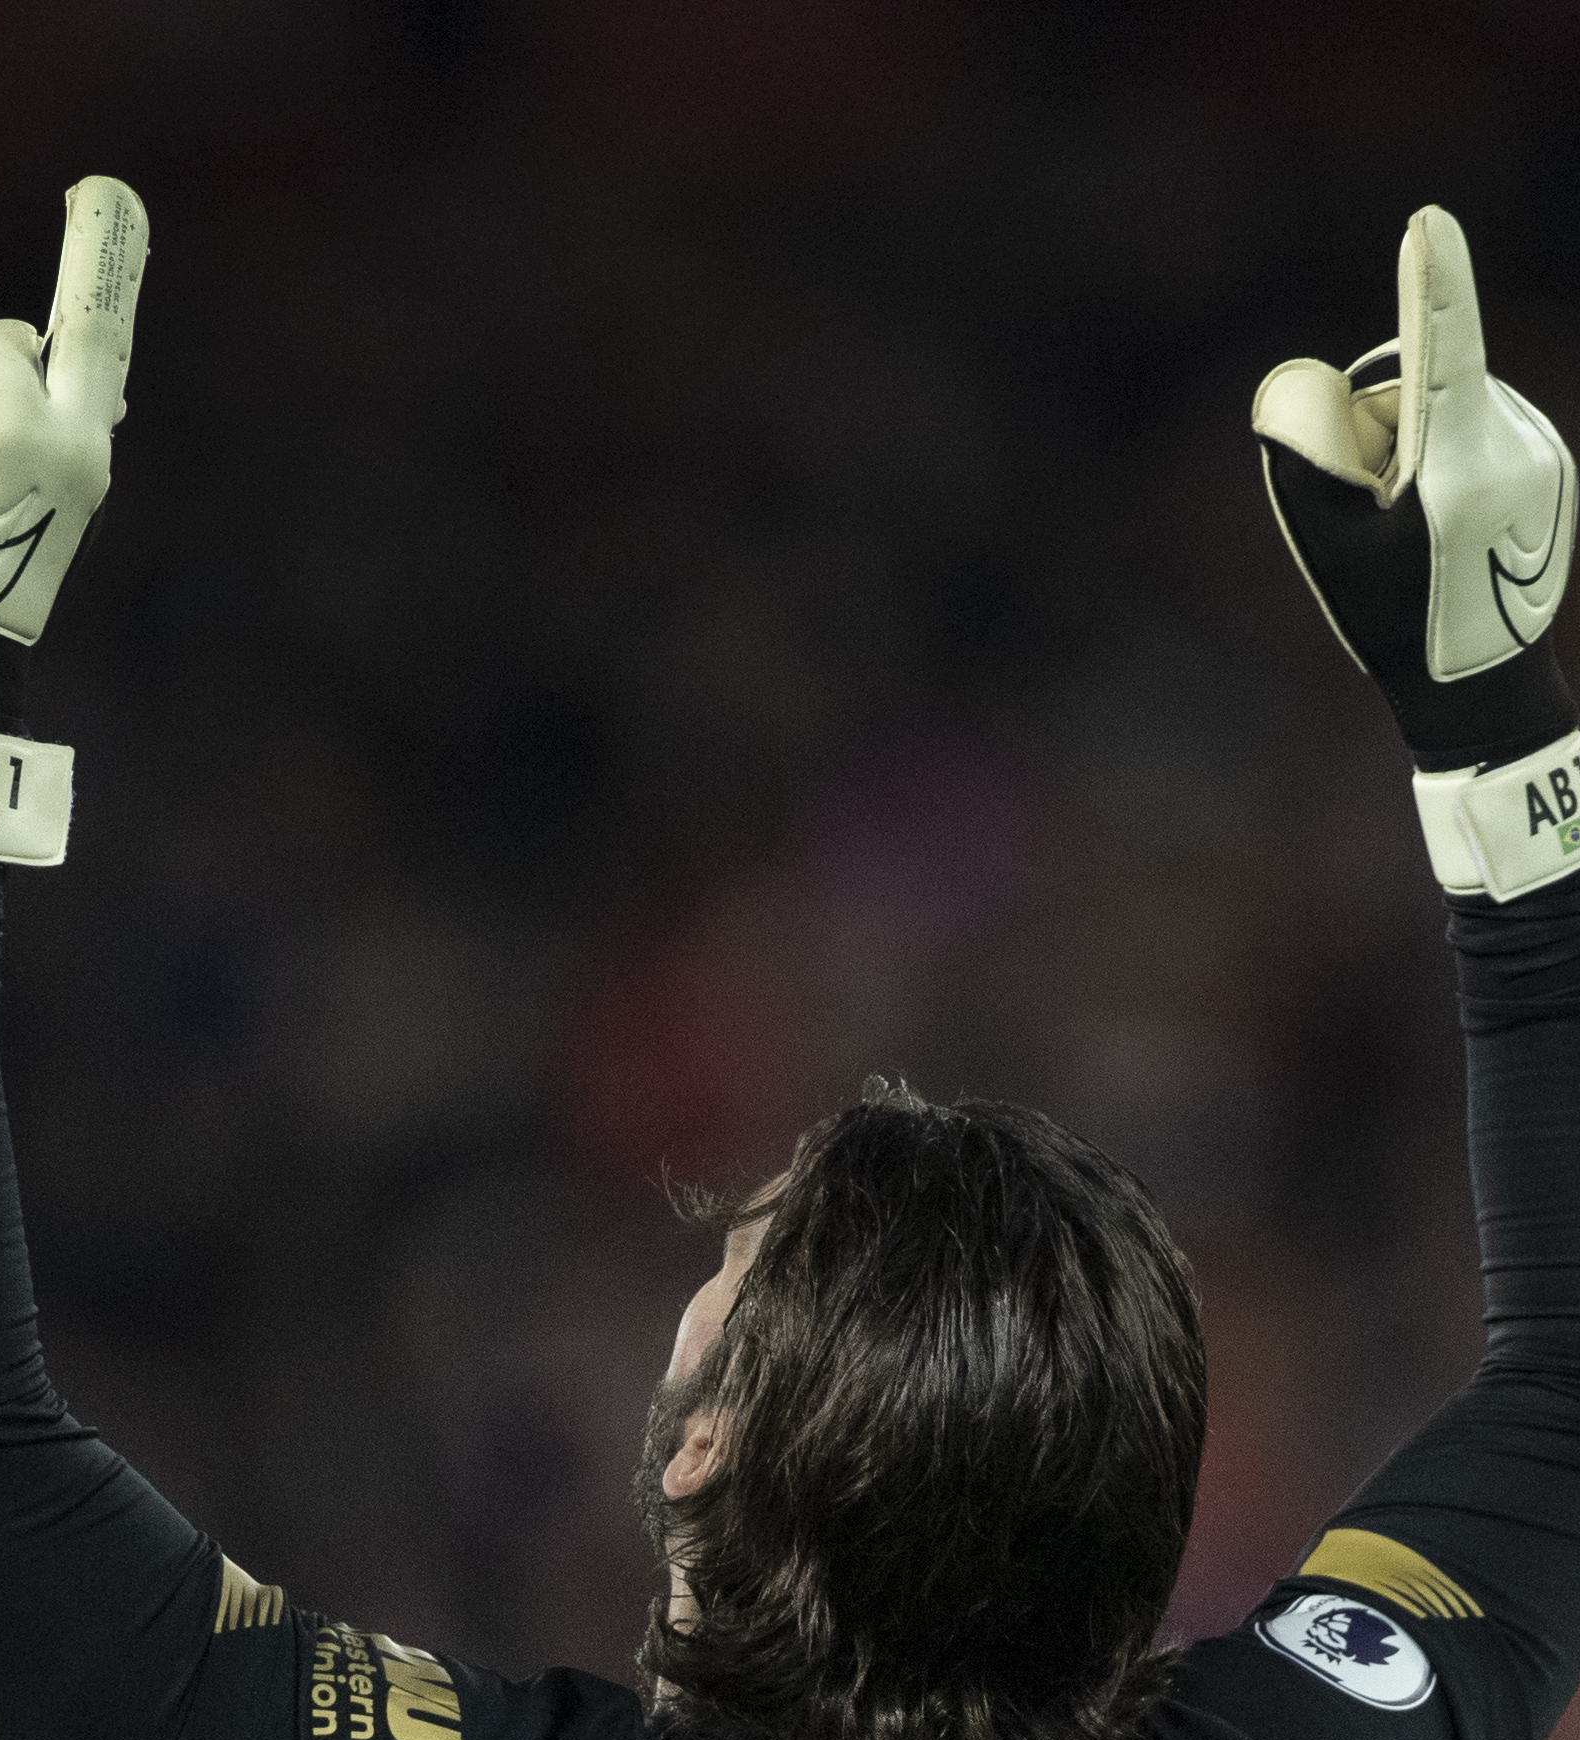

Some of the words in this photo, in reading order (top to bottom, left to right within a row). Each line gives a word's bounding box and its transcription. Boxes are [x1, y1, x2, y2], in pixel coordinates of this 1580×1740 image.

[97, 229, 111, 281] FOOTBALL
[104, 279, 113, 311] PROJECT
[112, 221, 120, 246] VAPOR
[96, 286, 104, 309] NIKE
[333, 1622, 377, 1740] estern
